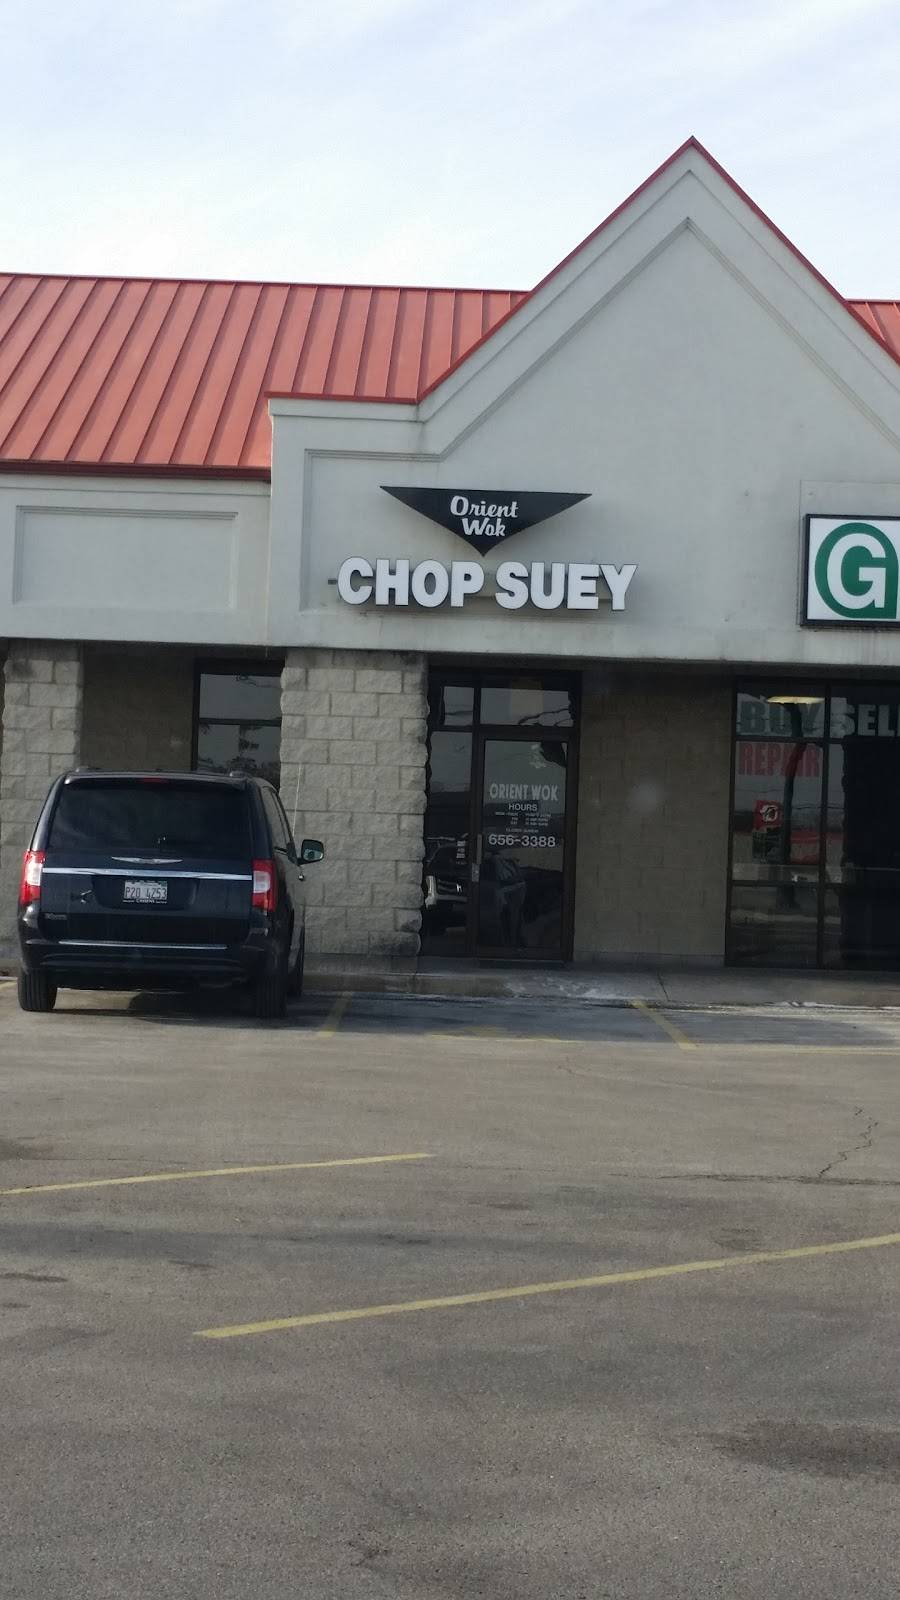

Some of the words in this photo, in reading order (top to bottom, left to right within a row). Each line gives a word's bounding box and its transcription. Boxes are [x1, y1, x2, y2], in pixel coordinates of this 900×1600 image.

[450, 495, 519, 518] Orient
[462, 518, 506, 537] Wok
[827, 533, 886, 609] G
[337, 557, 484, 608] CHOP
[495, 561, 637, 611] SUEY
[831, 703, 900, 738] SEL
[739, 742, 820, 777] REPAIR
[489, 783, 528, 800] ORIENT
[531, 784, 558, 801] WOK
[508, 803, 538, 811] HOURS
[488, 833, 556, 848] 656-3388
